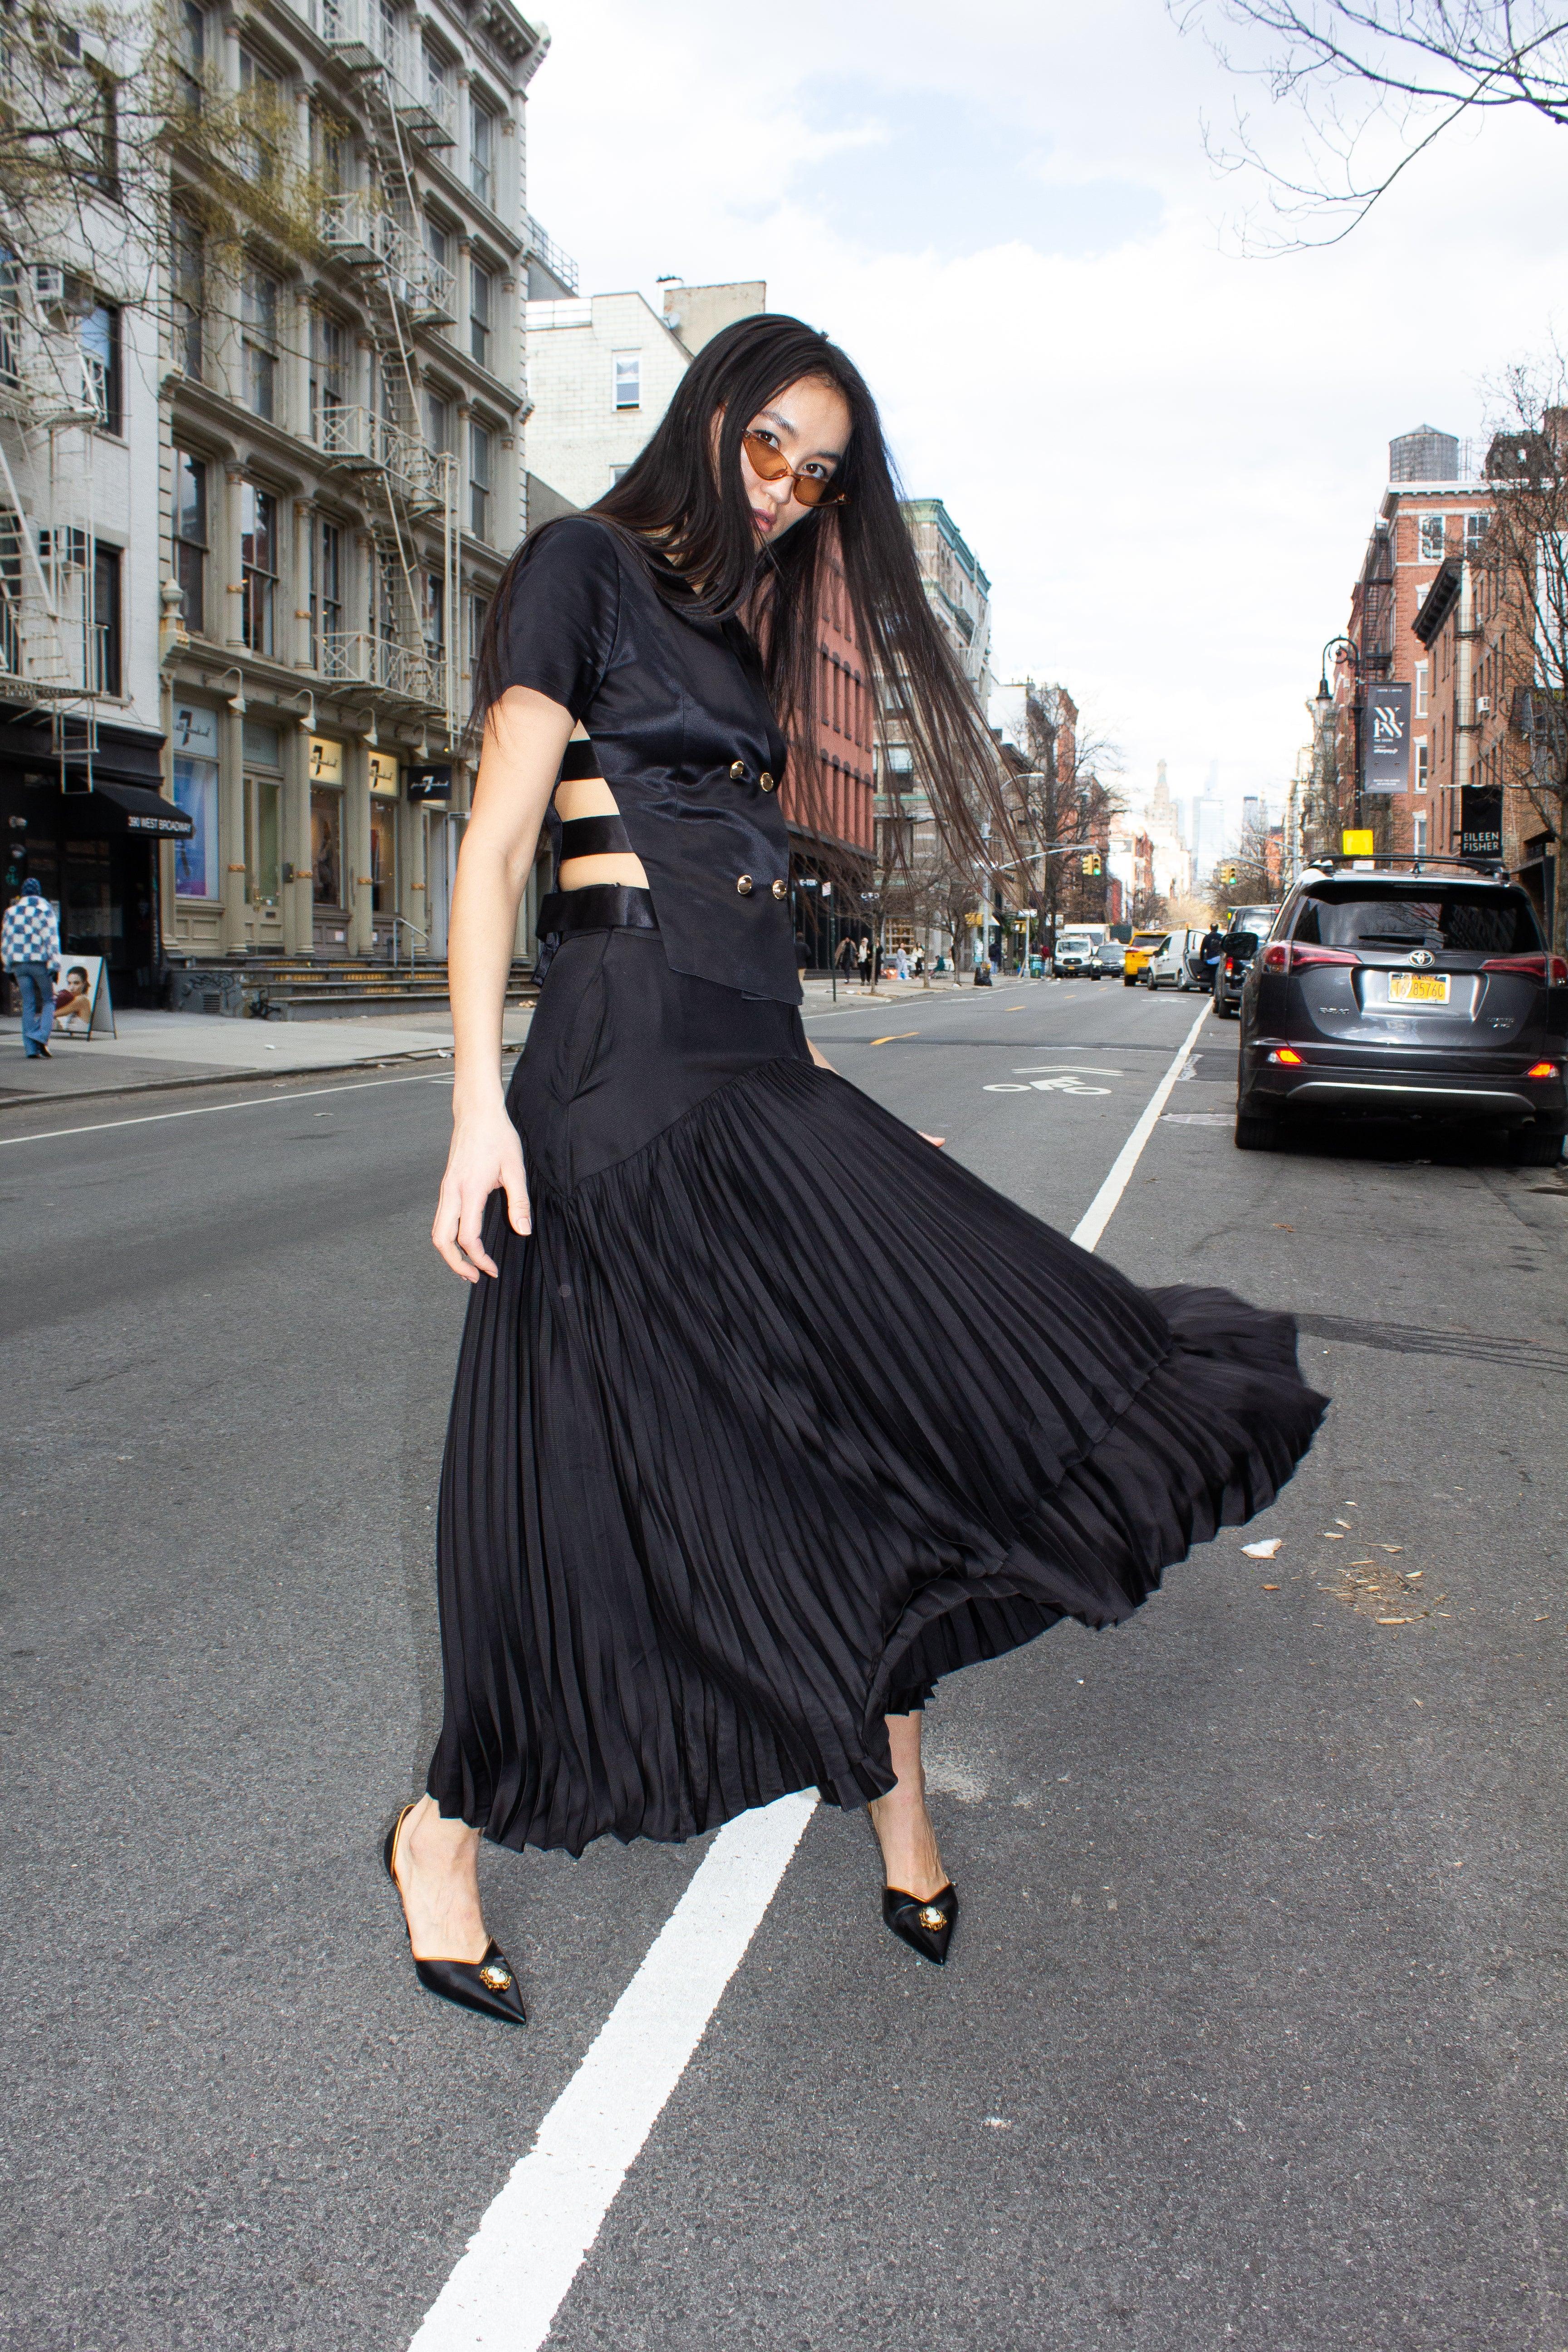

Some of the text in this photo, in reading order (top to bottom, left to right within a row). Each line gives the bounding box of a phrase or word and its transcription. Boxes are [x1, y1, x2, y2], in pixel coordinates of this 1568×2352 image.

[178, 710, 192, 746] 7
[313, 745, 323, 776] 7
[371, 760, 379, 788] 7
[422, 776, 434, 793] 7
[141, 817, 158, 830] WEST
[159, 819, 191, 833] BROADWAY
[1464, 832, 1499, 842] EILEEN
[1464, 842, 1499, 852] FISHER
